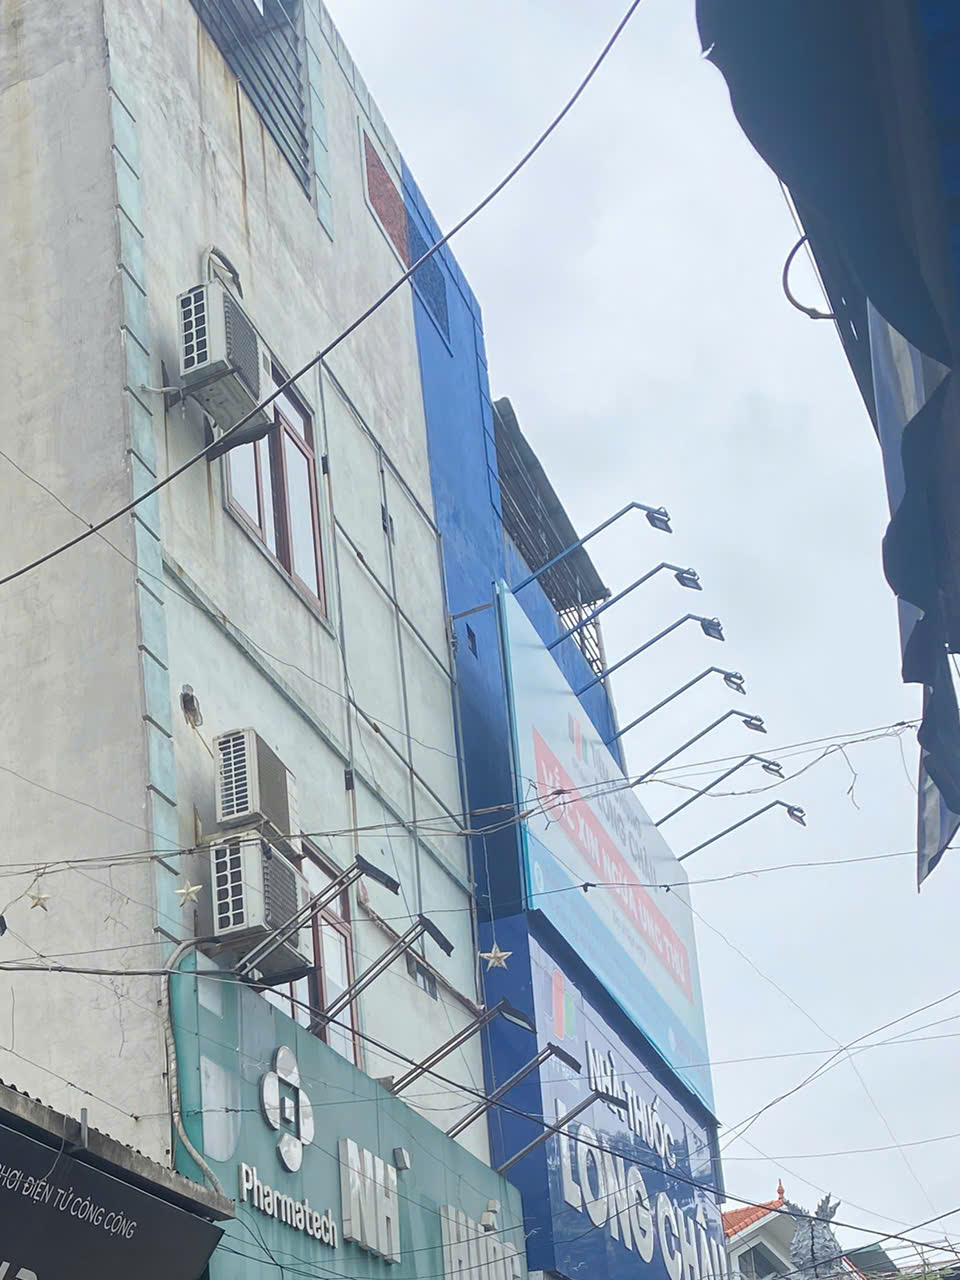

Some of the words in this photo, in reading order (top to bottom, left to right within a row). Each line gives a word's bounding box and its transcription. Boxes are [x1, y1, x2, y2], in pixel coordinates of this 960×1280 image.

[24, 1175, 52, 1205] ĐIỆN
[52, 1186, 72, 1212] TỬ
[70, 1193, 106, 1226] CÔNG
[107, 1208, 138, 1240] CỘNG
[239, 1161, 338, 1250] Pharmatech
[554, 1097, 655, 1264] LONG
